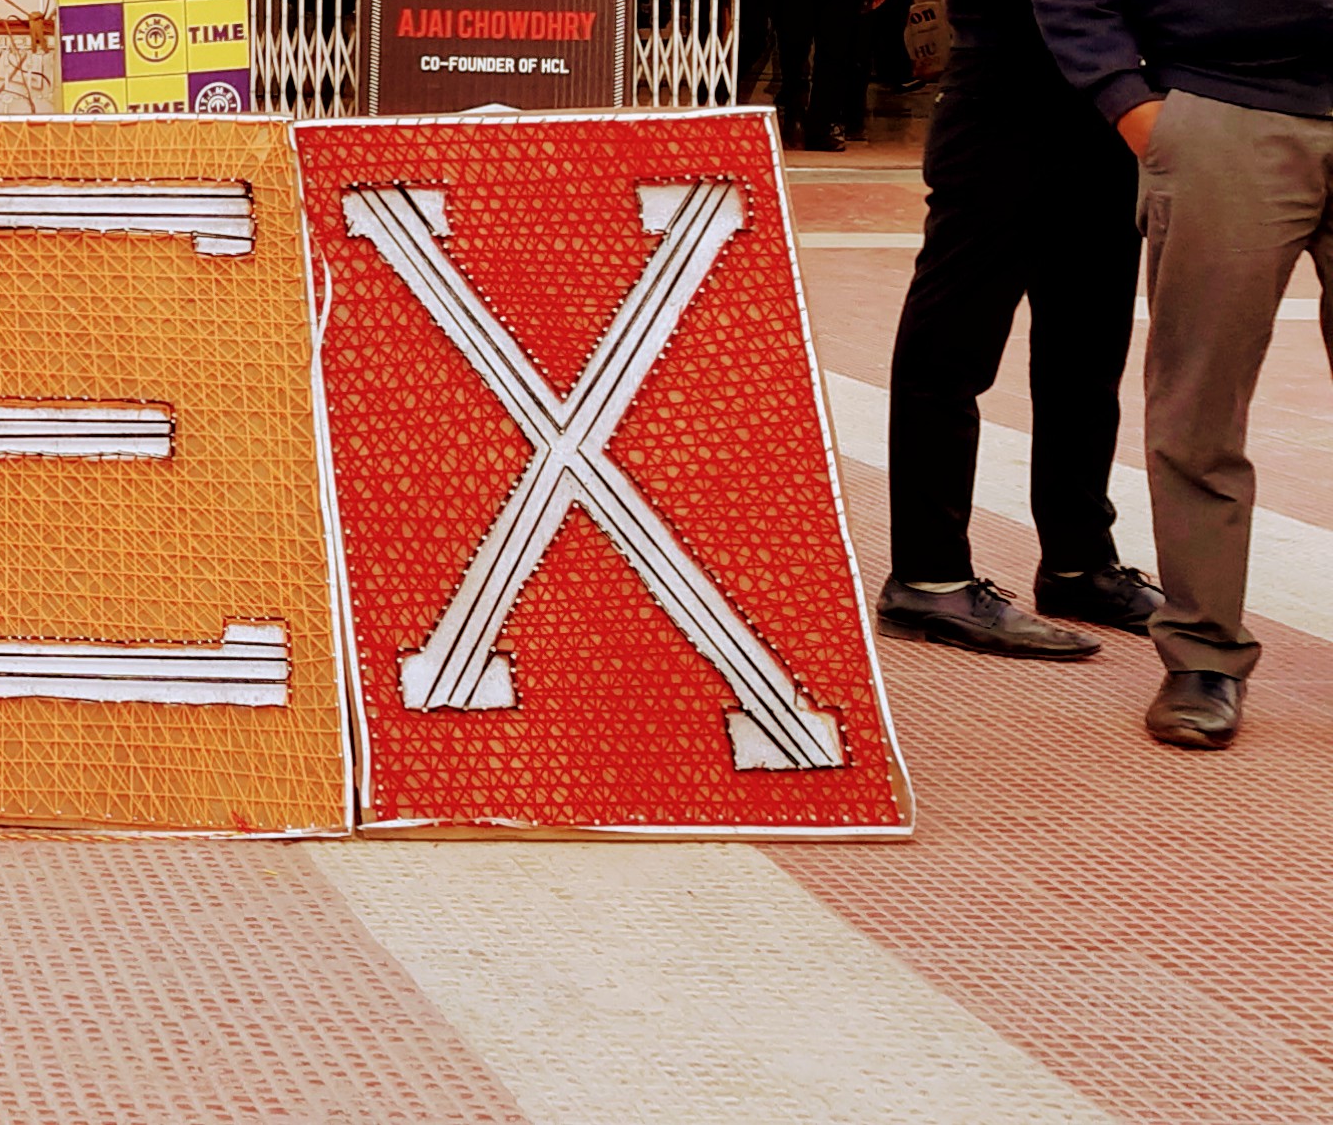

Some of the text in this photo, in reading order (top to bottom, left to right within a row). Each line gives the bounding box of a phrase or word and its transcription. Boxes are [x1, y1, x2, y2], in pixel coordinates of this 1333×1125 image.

[397, 8, 597, 41] AJAI CHOWDHRY
[420, 56, 570, 74] CO-FOUNDER OF HCL
